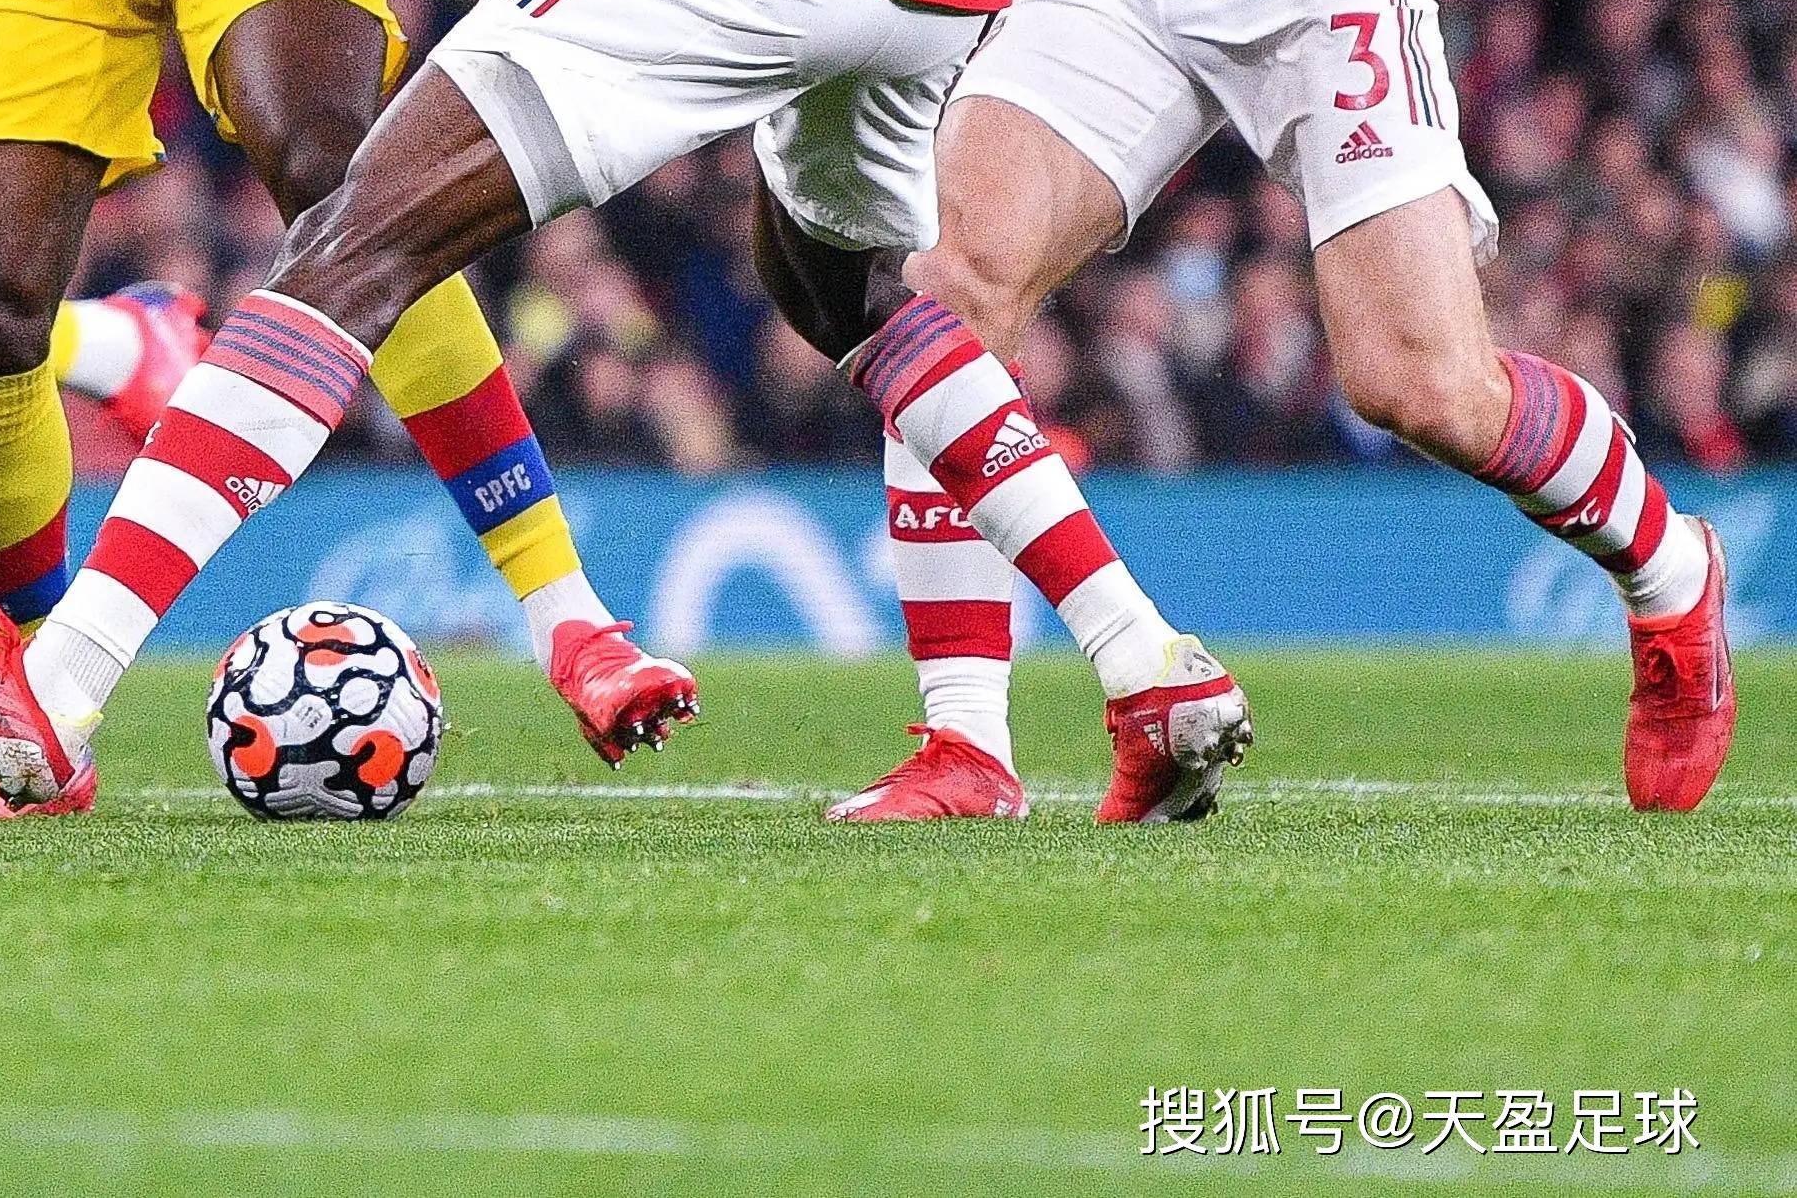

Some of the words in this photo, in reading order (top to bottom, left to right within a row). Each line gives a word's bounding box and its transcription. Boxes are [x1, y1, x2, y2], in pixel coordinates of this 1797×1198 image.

[1330, 12, 1390, 110] 3
[1335, 147, 1394, 164] adidas
[475, 463, 531, 512] CPFC
